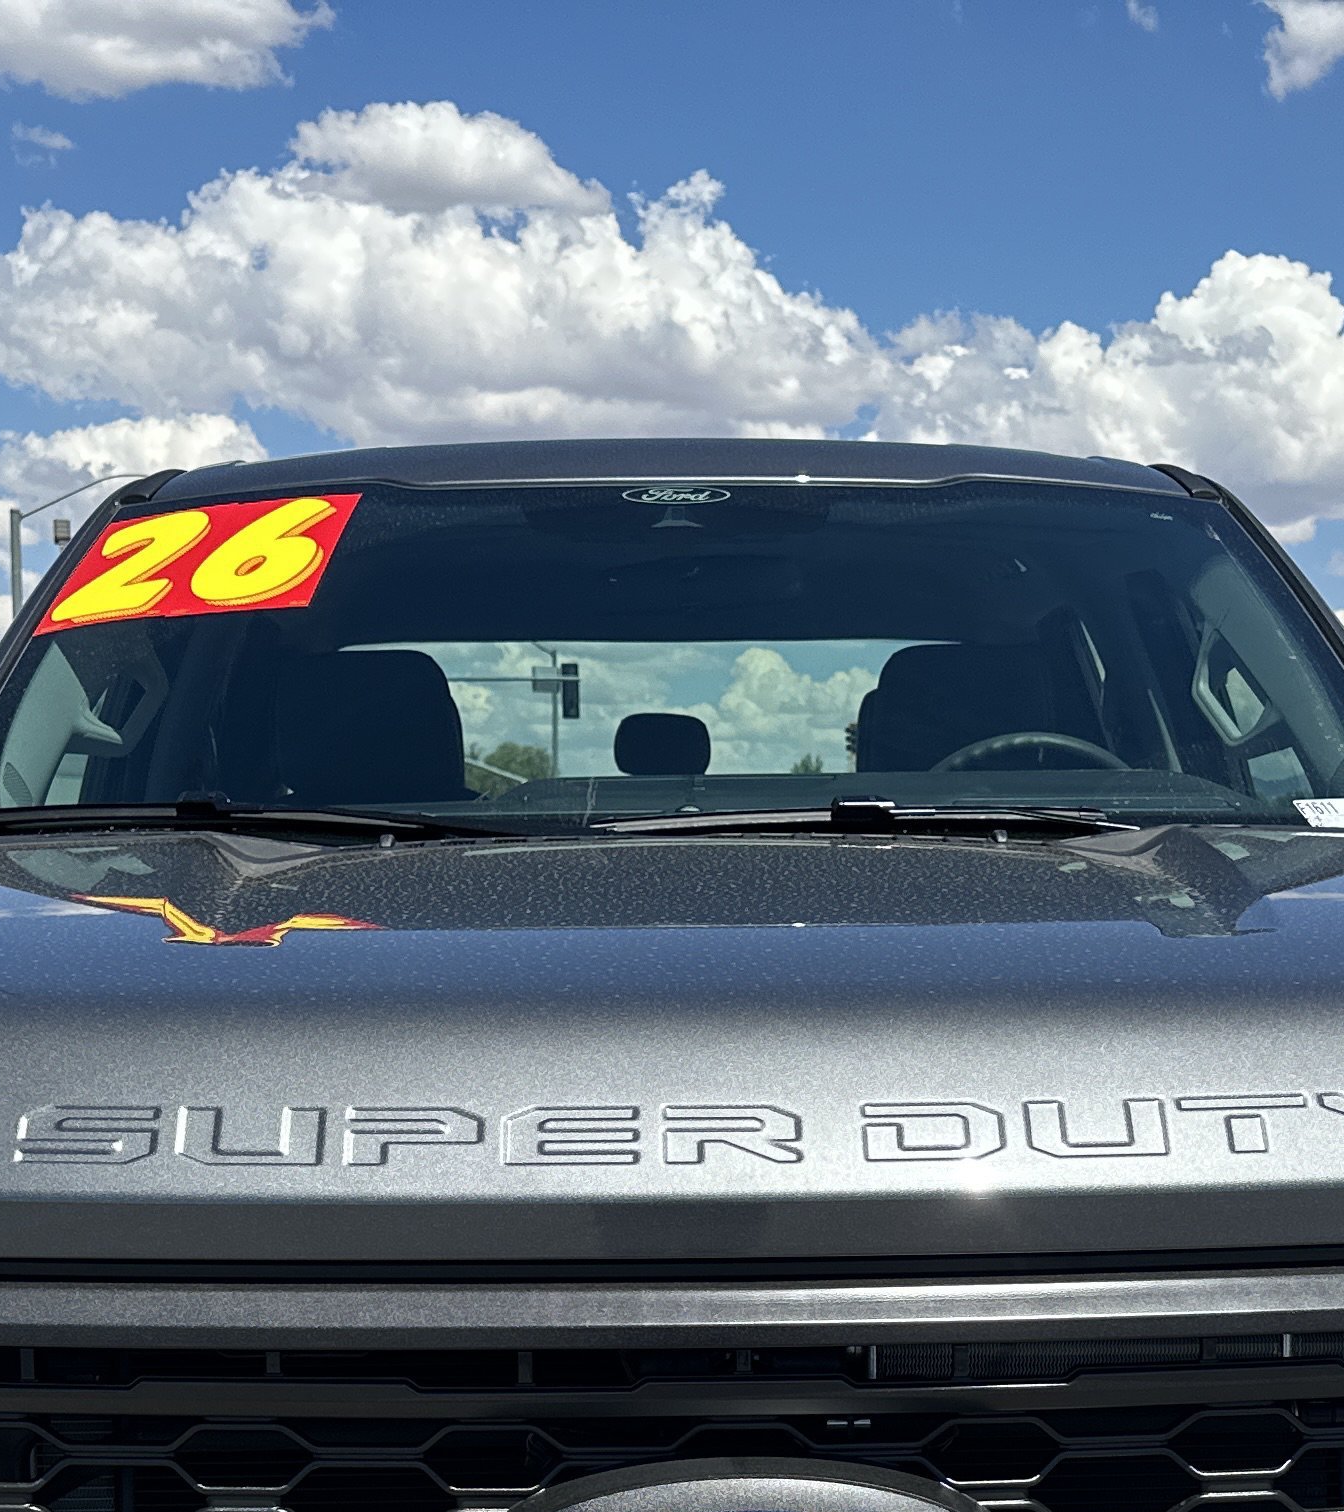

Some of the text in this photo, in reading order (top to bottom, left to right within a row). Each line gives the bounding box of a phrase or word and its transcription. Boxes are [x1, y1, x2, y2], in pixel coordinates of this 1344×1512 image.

[641, 488, 711, 501] Ford
[50, 498, 337, 624] 26
[12, 1104, 803, 1166] SUPER
